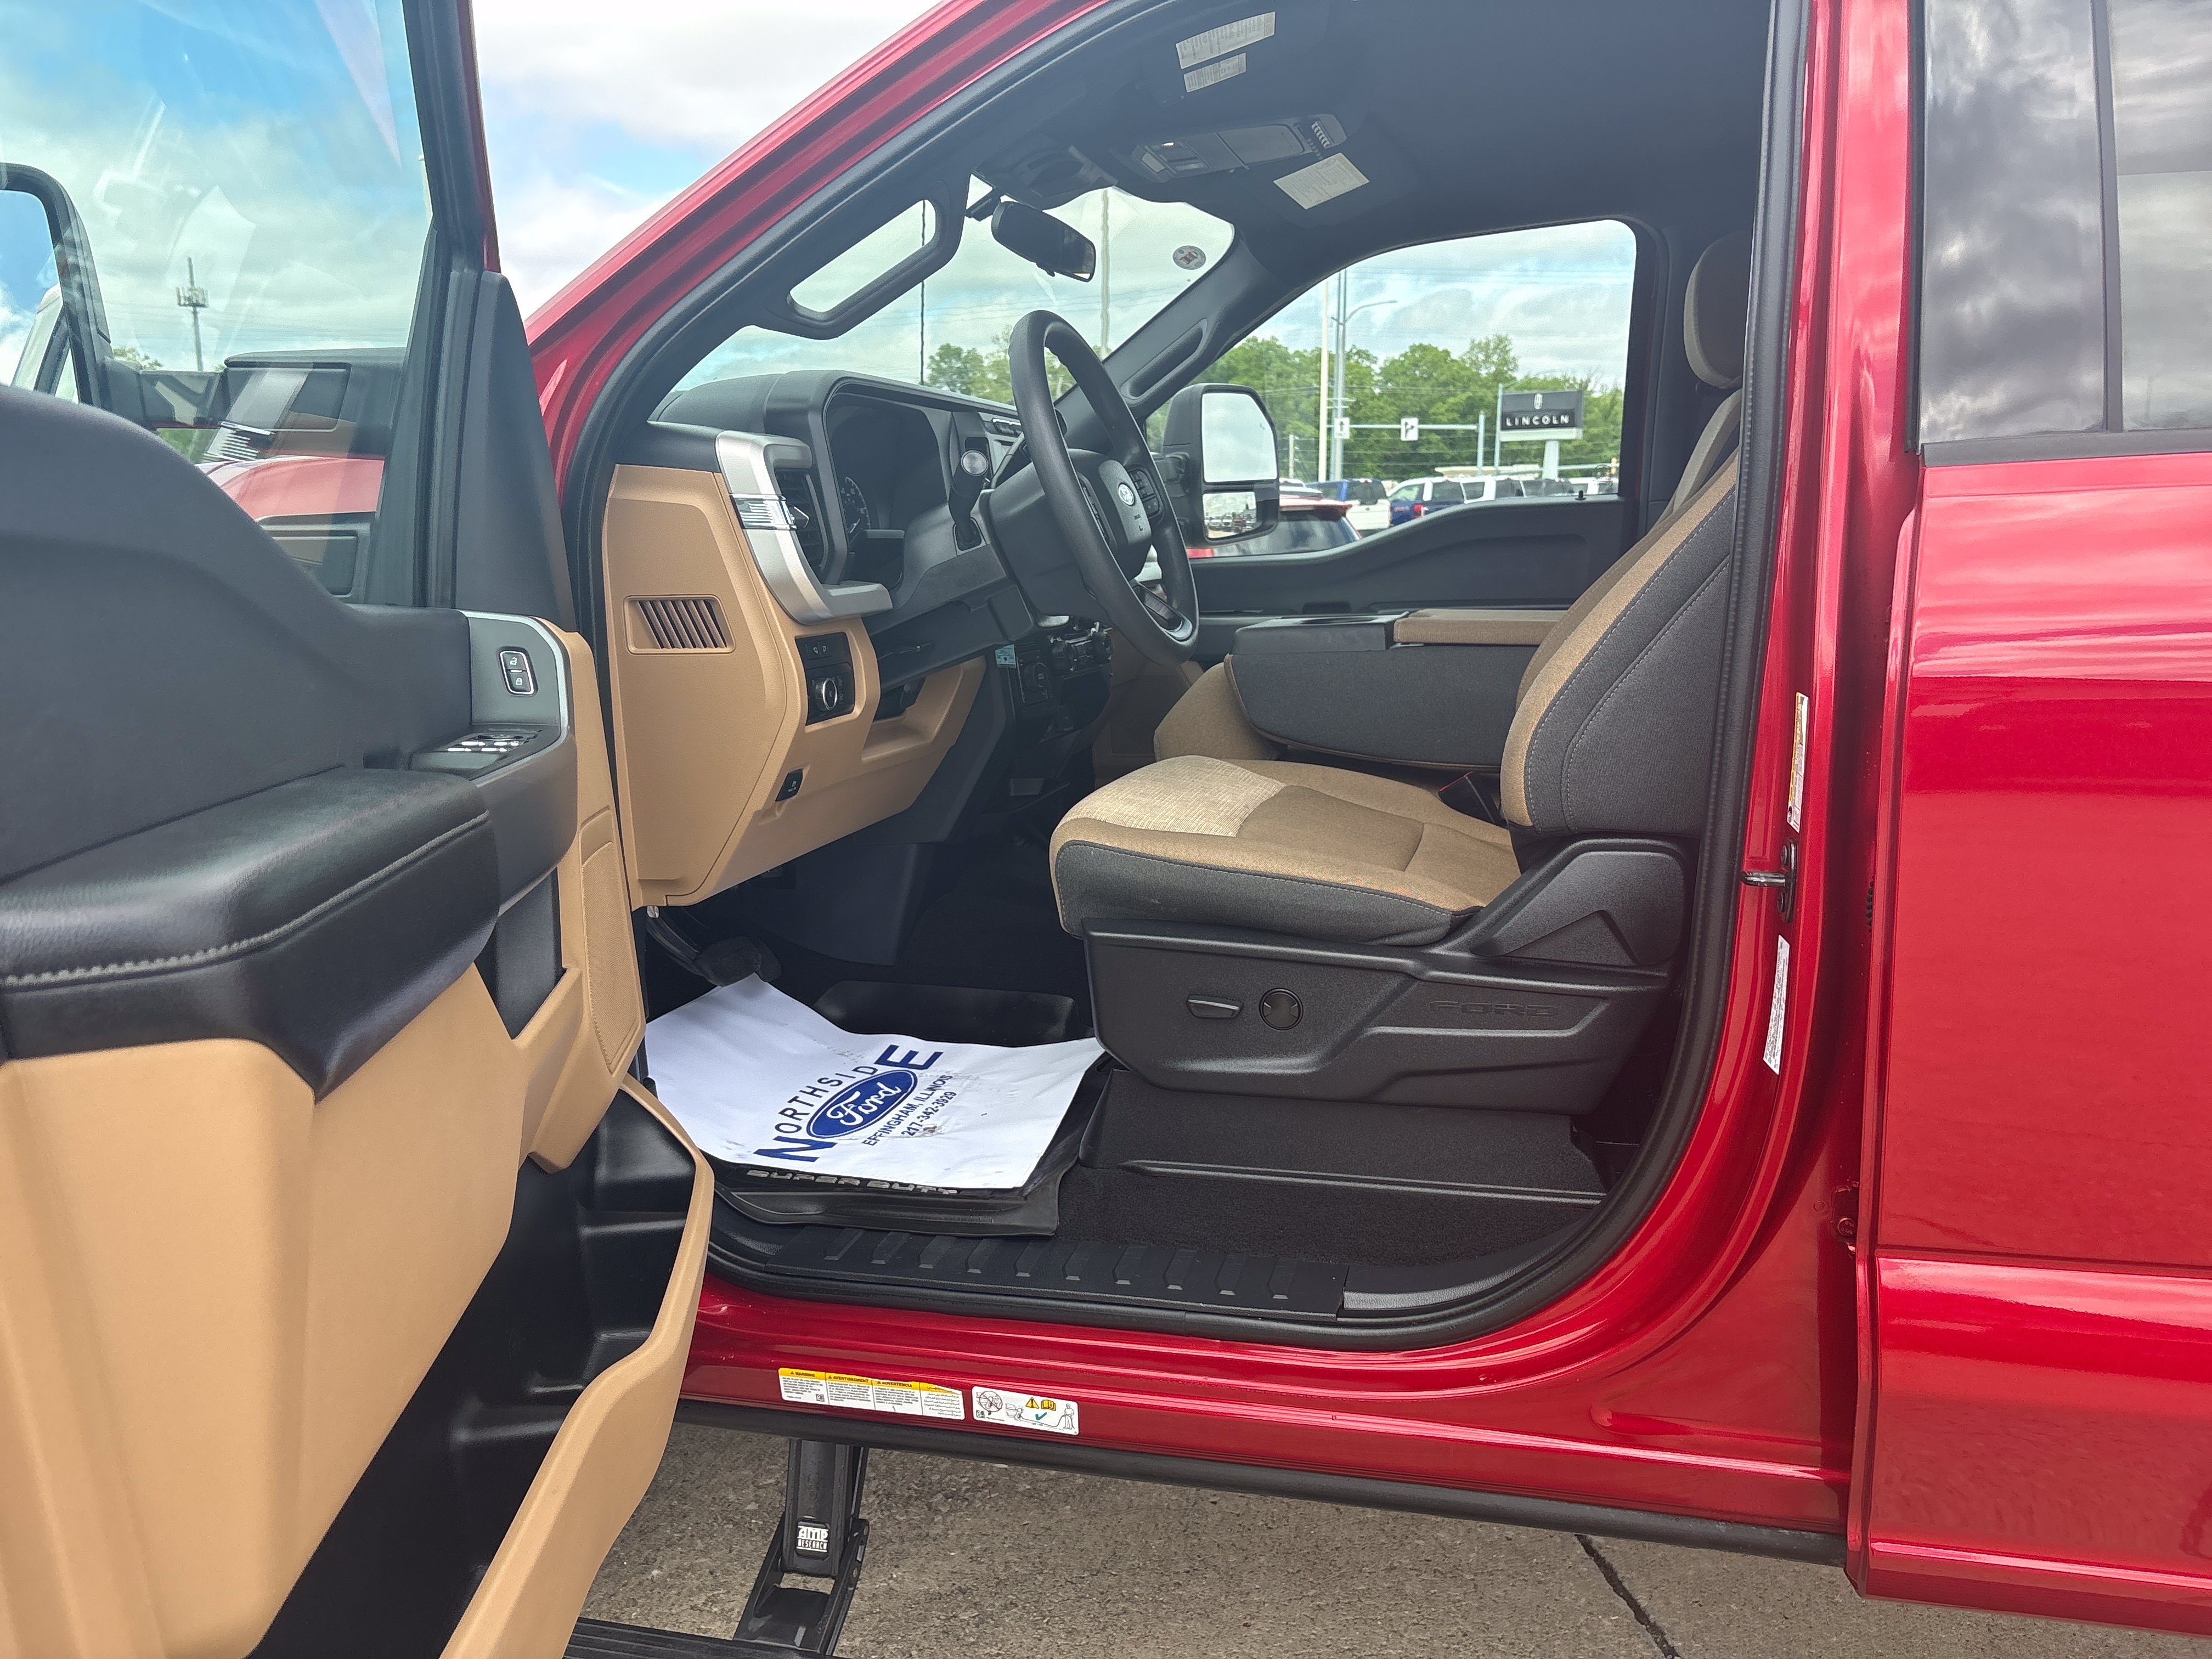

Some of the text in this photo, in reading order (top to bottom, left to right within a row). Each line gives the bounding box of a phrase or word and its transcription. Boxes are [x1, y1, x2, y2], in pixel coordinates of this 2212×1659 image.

[1505, 413, 1570, 426] LINCOLN
[1430, 1000, 1559, 1017] FORD
[753, 1044, 944, 1163] NORTHSIDE
[826, 1081, 902, 1126] Ford
[861, 1075, 953, 1146] EFFINGHAM, ILLINOIS
[901, 1091, 957, 1136] 217-342-3929
[746, 1169, 958, 1195] SUPER DUTY
[797, 1527, 828, 1541] AMP
